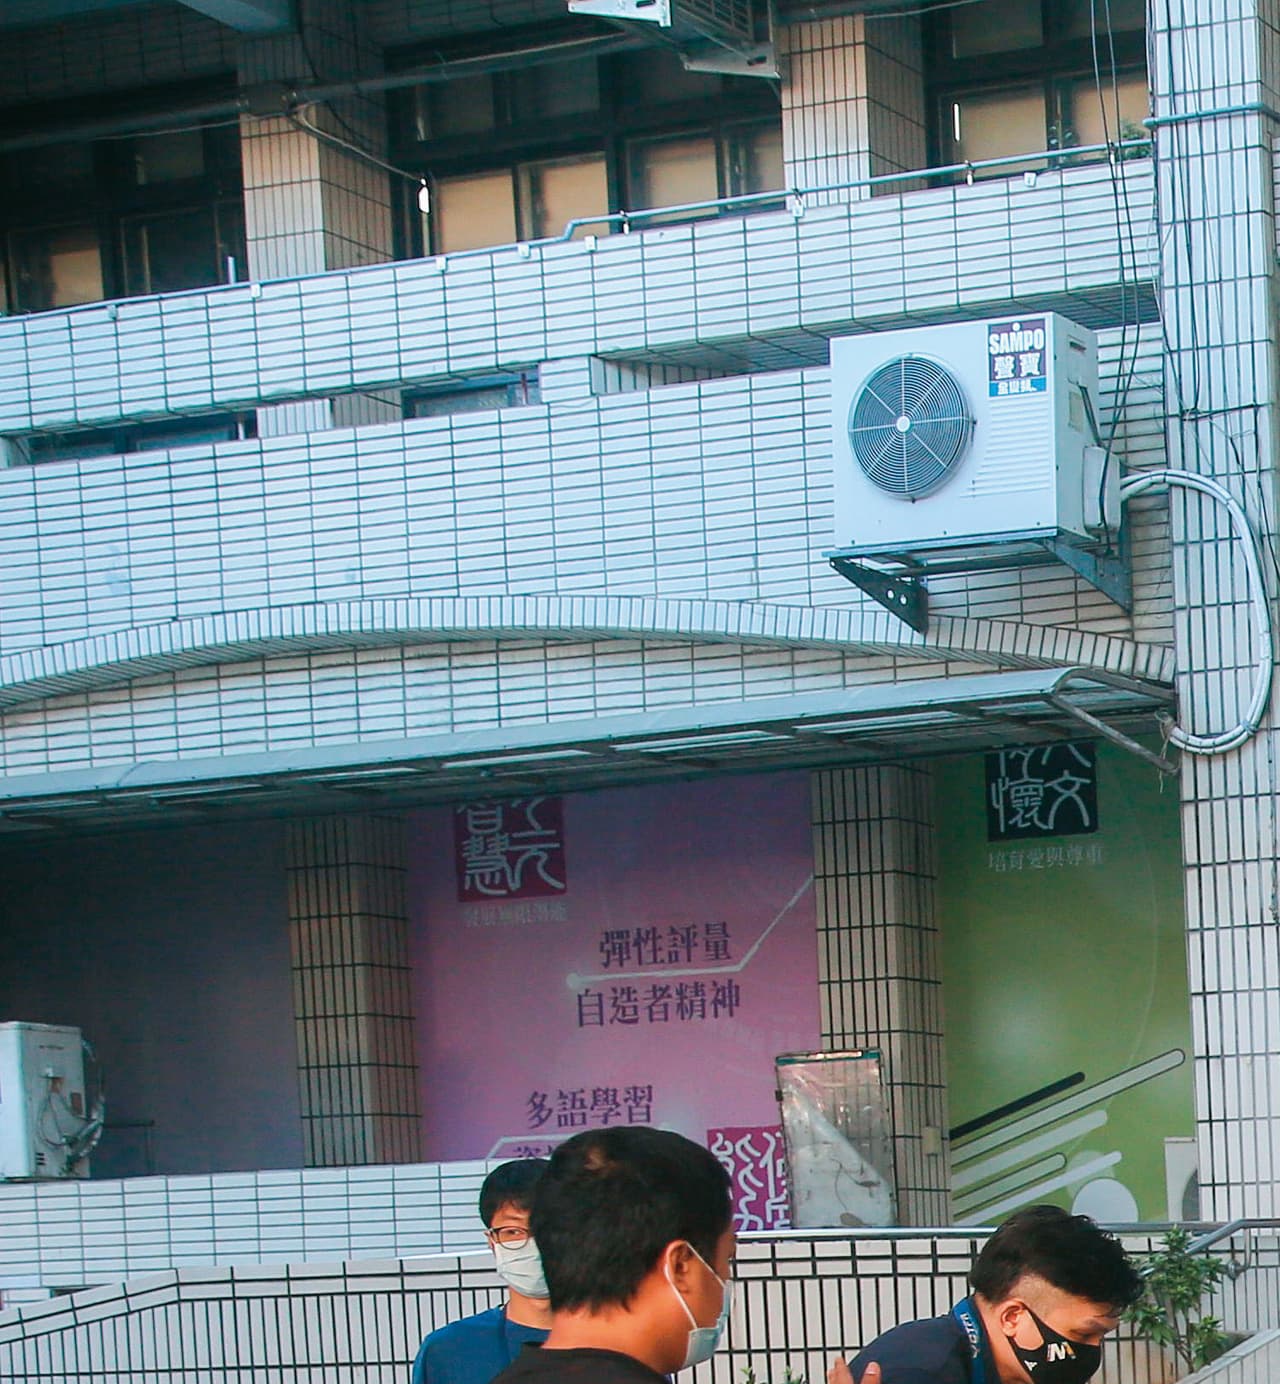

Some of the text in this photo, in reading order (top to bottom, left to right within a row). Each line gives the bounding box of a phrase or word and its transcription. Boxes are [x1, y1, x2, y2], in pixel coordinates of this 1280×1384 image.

[989, 328, 1044, 354] SAMPO
[599, 922, 731, 969] 彈性評量
[577, 980, 741, 1028] 自造者精神
[527, 1085, 653, 1130] 多語學習
